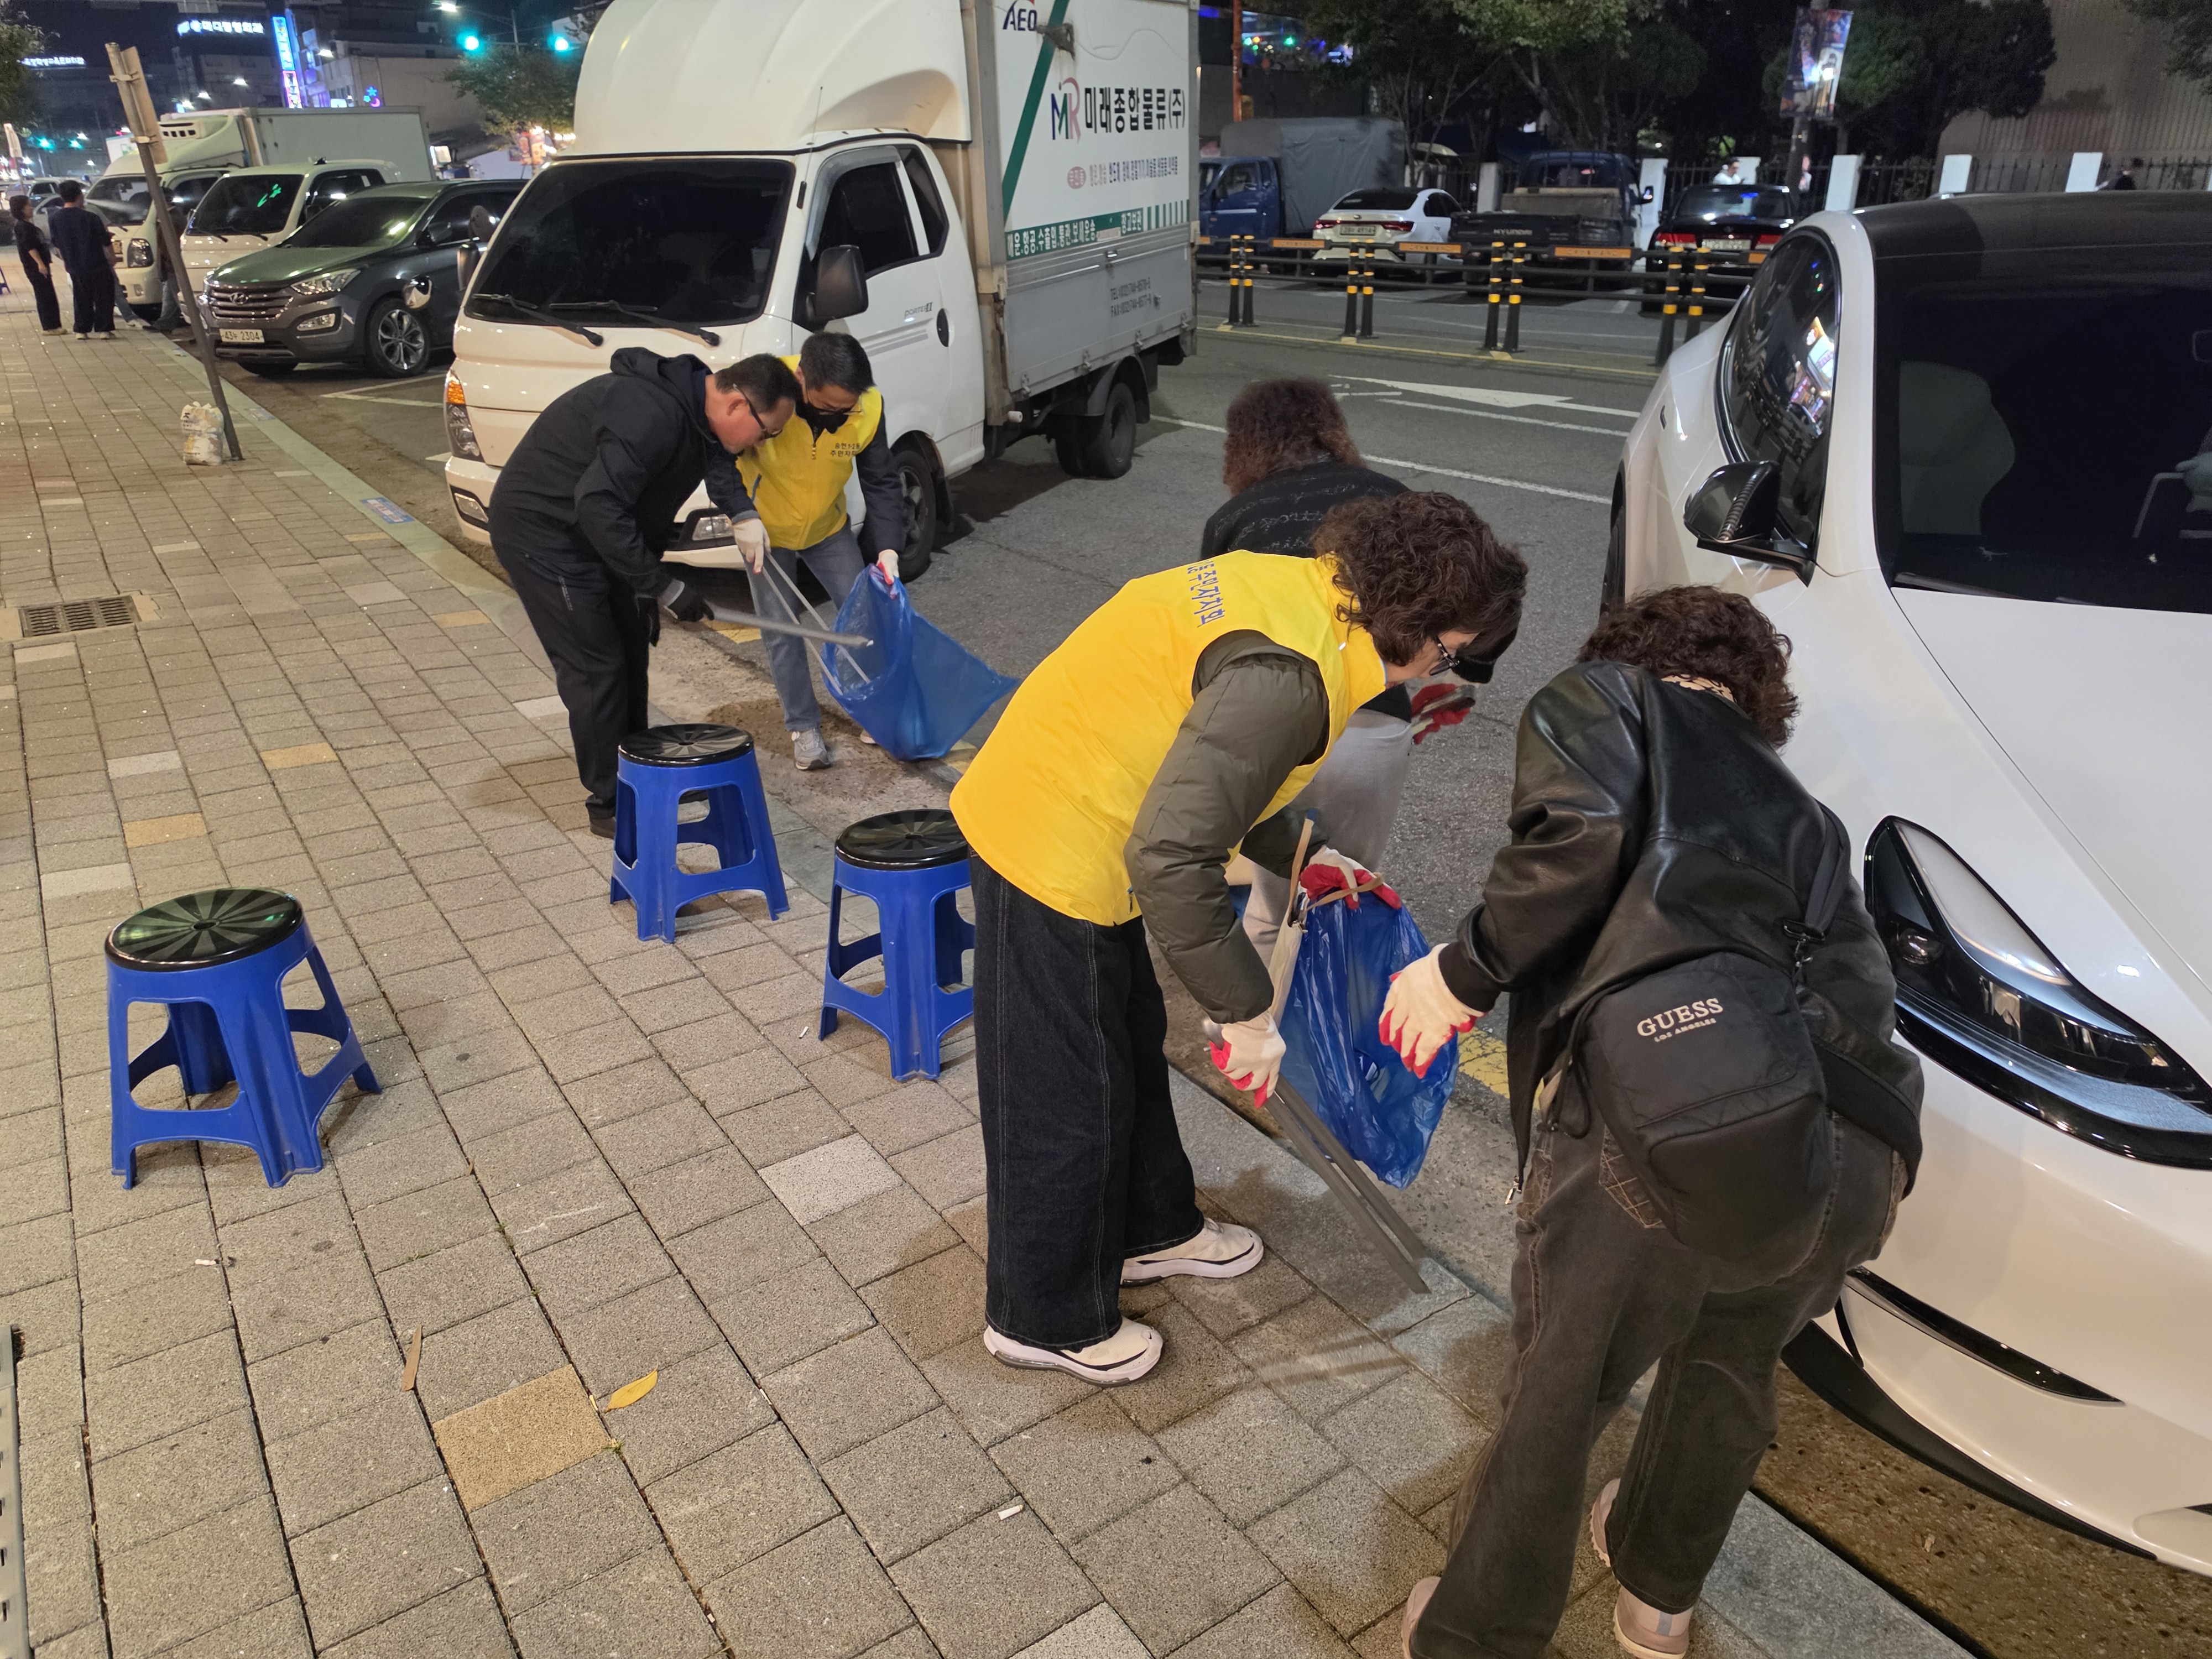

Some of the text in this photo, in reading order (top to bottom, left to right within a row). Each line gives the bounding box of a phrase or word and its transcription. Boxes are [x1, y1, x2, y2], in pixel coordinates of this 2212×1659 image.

[1003, 4, 1037, 31] AEO
[1084, 87, 1185, 133] 미래종합물류(주)
[241, 331, 260, 341] 2304
[1637, 998, 1723, 1037] GUESS
[1653, 1018, 1717, 1042] LOS ANGELES
